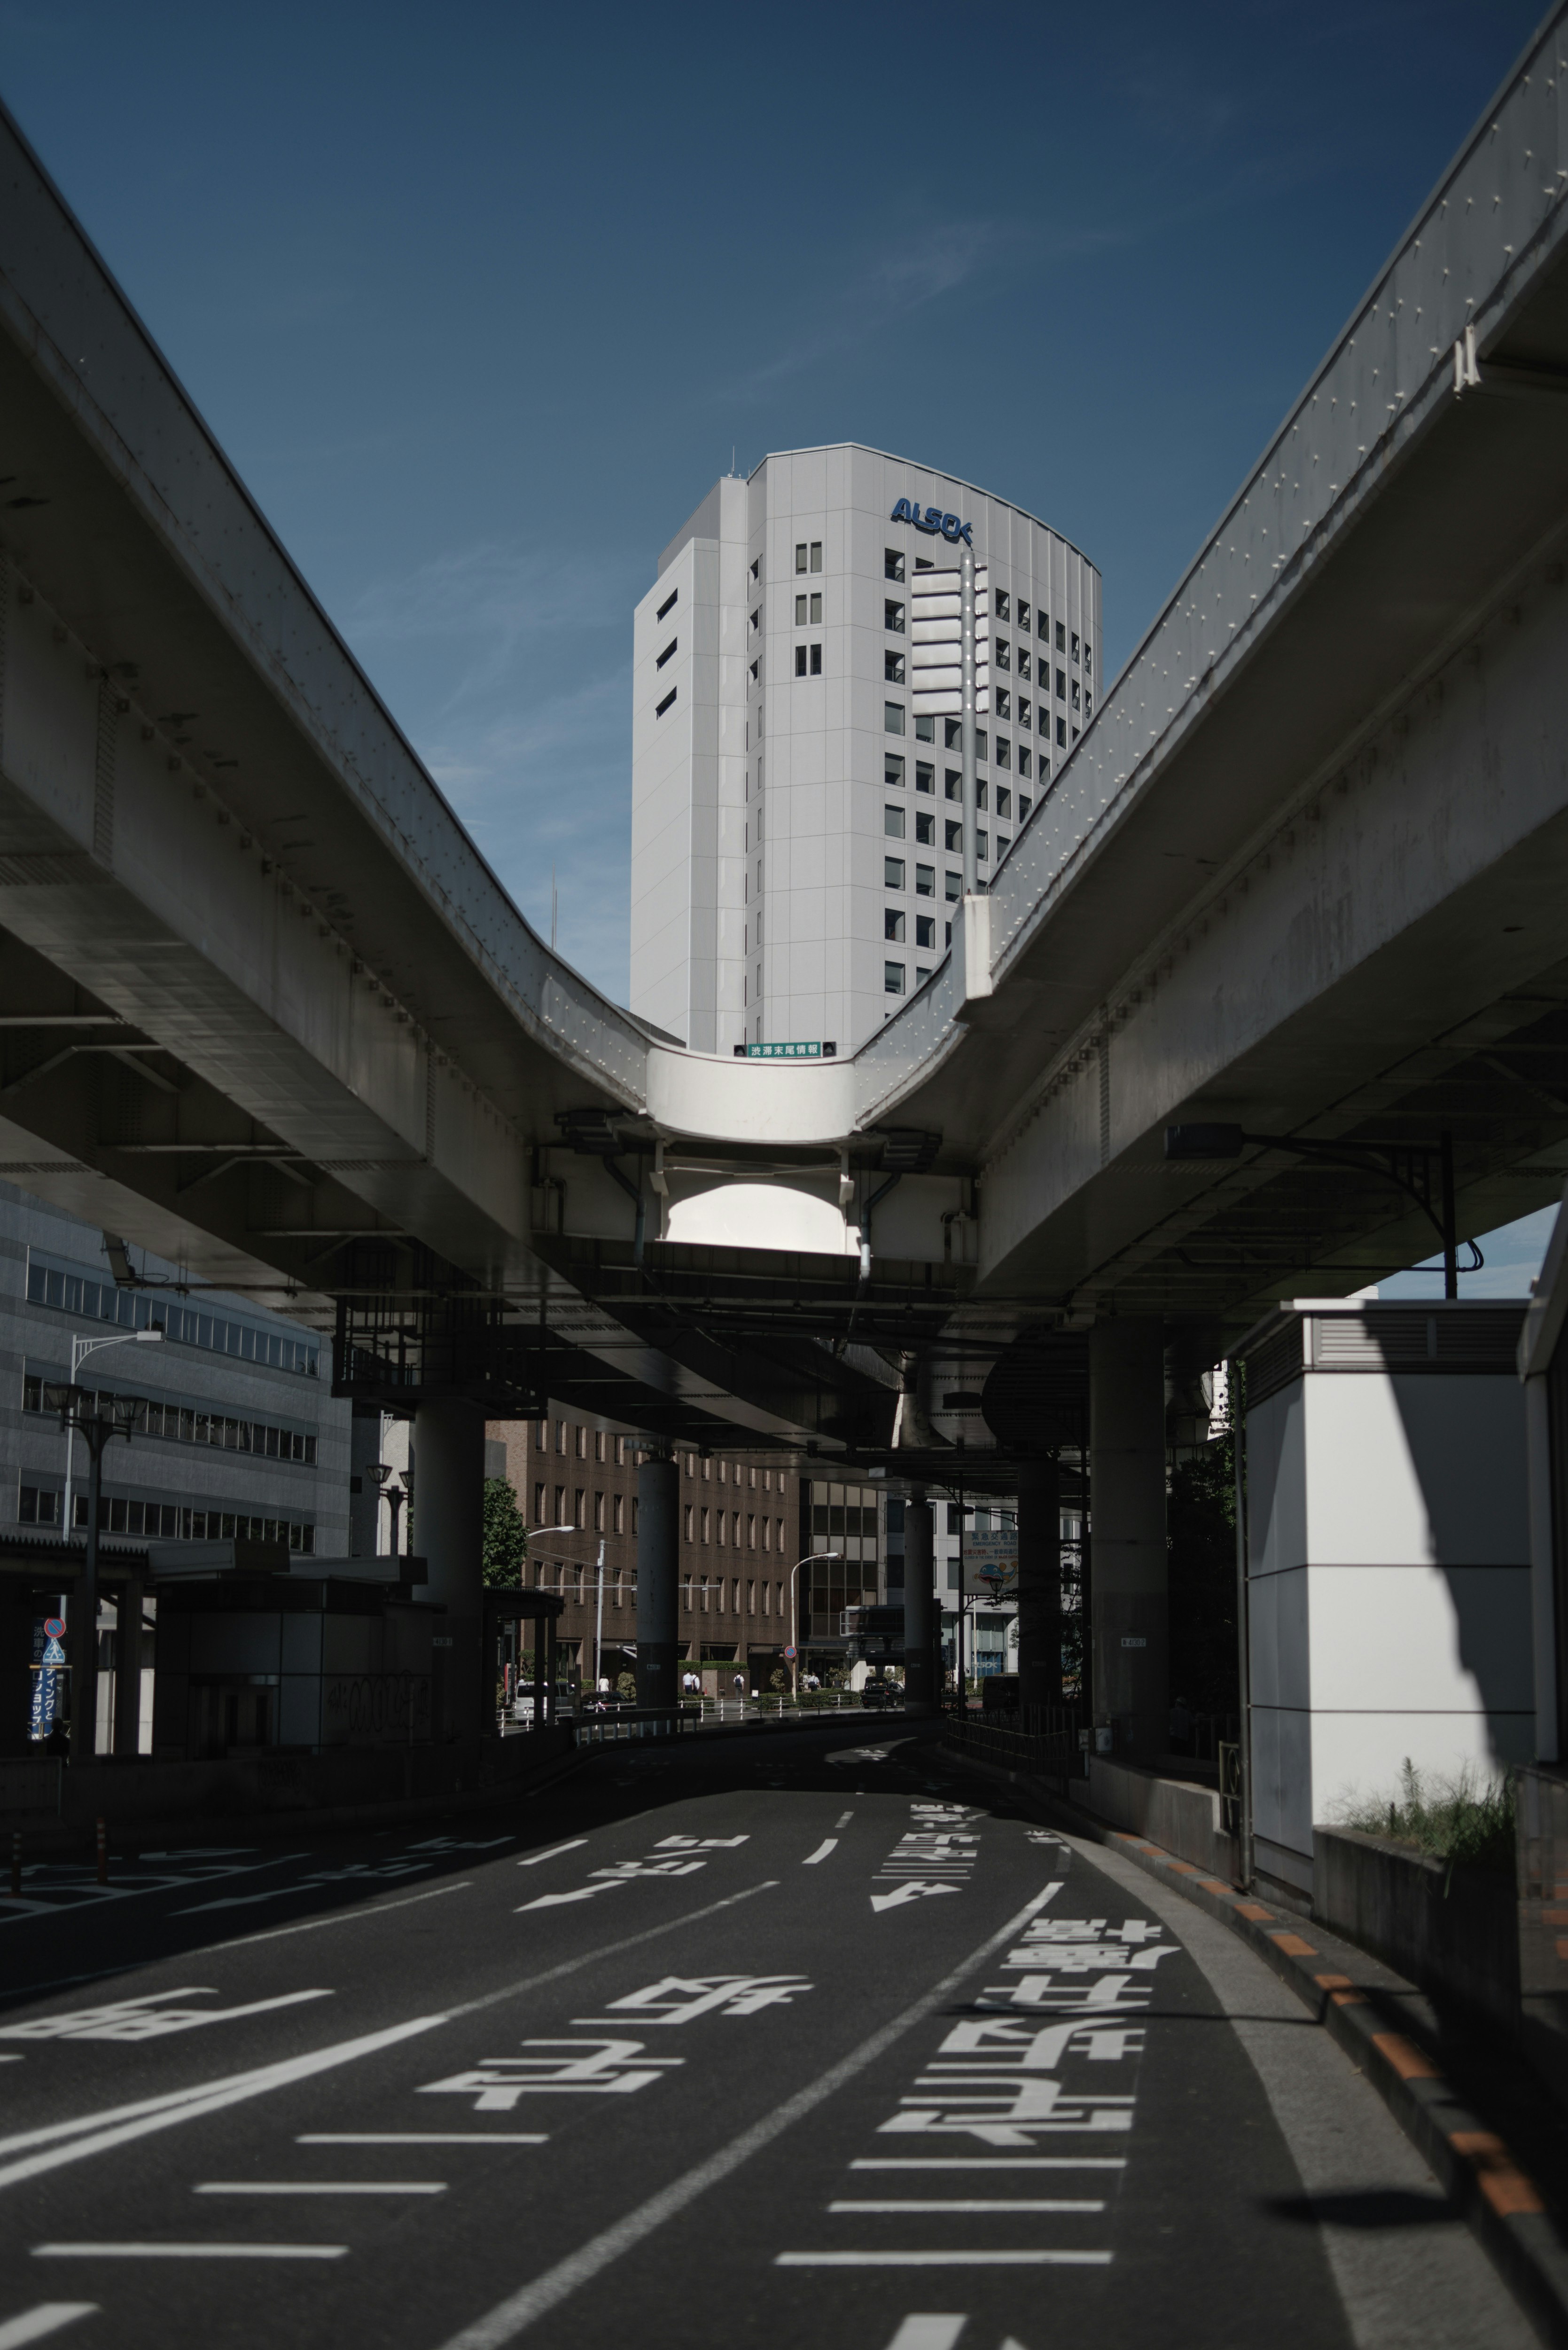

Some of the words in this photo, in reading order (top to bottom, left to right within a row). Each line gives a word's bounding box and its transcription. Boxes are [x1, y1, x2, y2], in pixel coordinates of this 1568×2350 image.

[891, 498, 973, 543] ALSOK
[751, 1044, 818, 1056] 渋滞末尾情報
